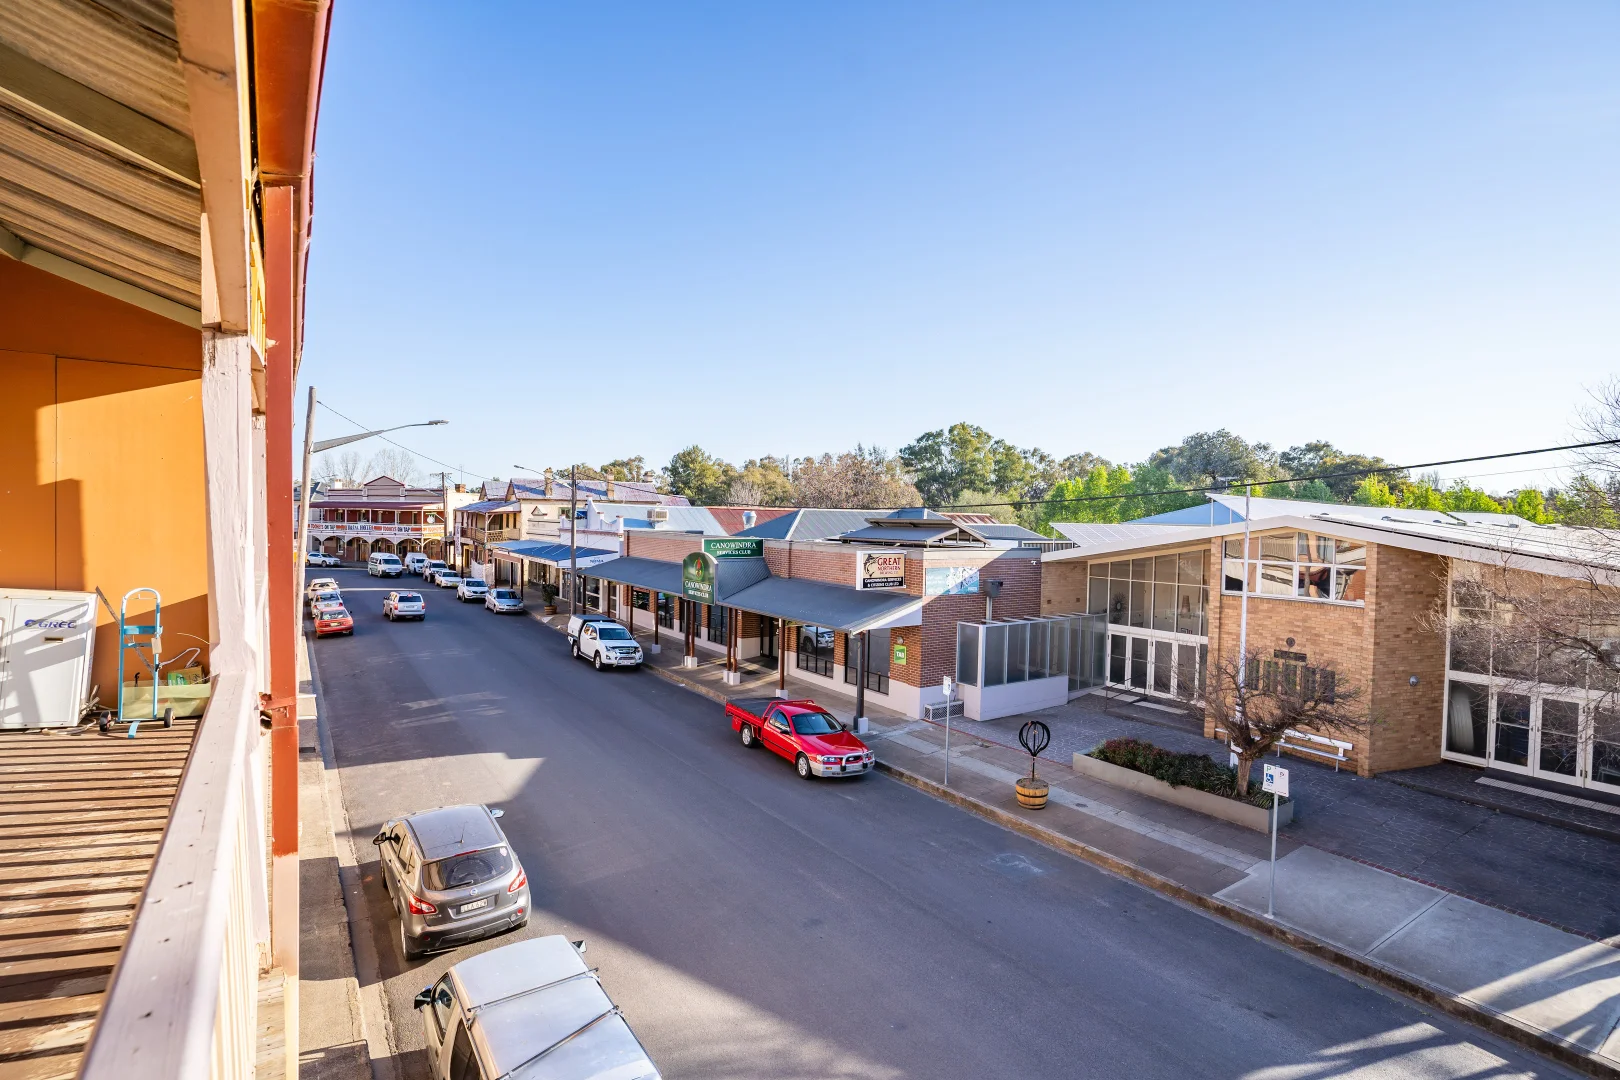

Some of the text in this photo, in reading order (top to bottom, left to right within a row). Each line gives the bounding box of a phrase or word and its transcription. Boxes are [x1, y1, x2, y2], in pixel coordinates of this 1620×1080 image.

[711, 541, 756, 549] CANOWINDRA
[877, 558, 901, 566] GREAT
[685, 581, 712, 592] CANOWINDRA
